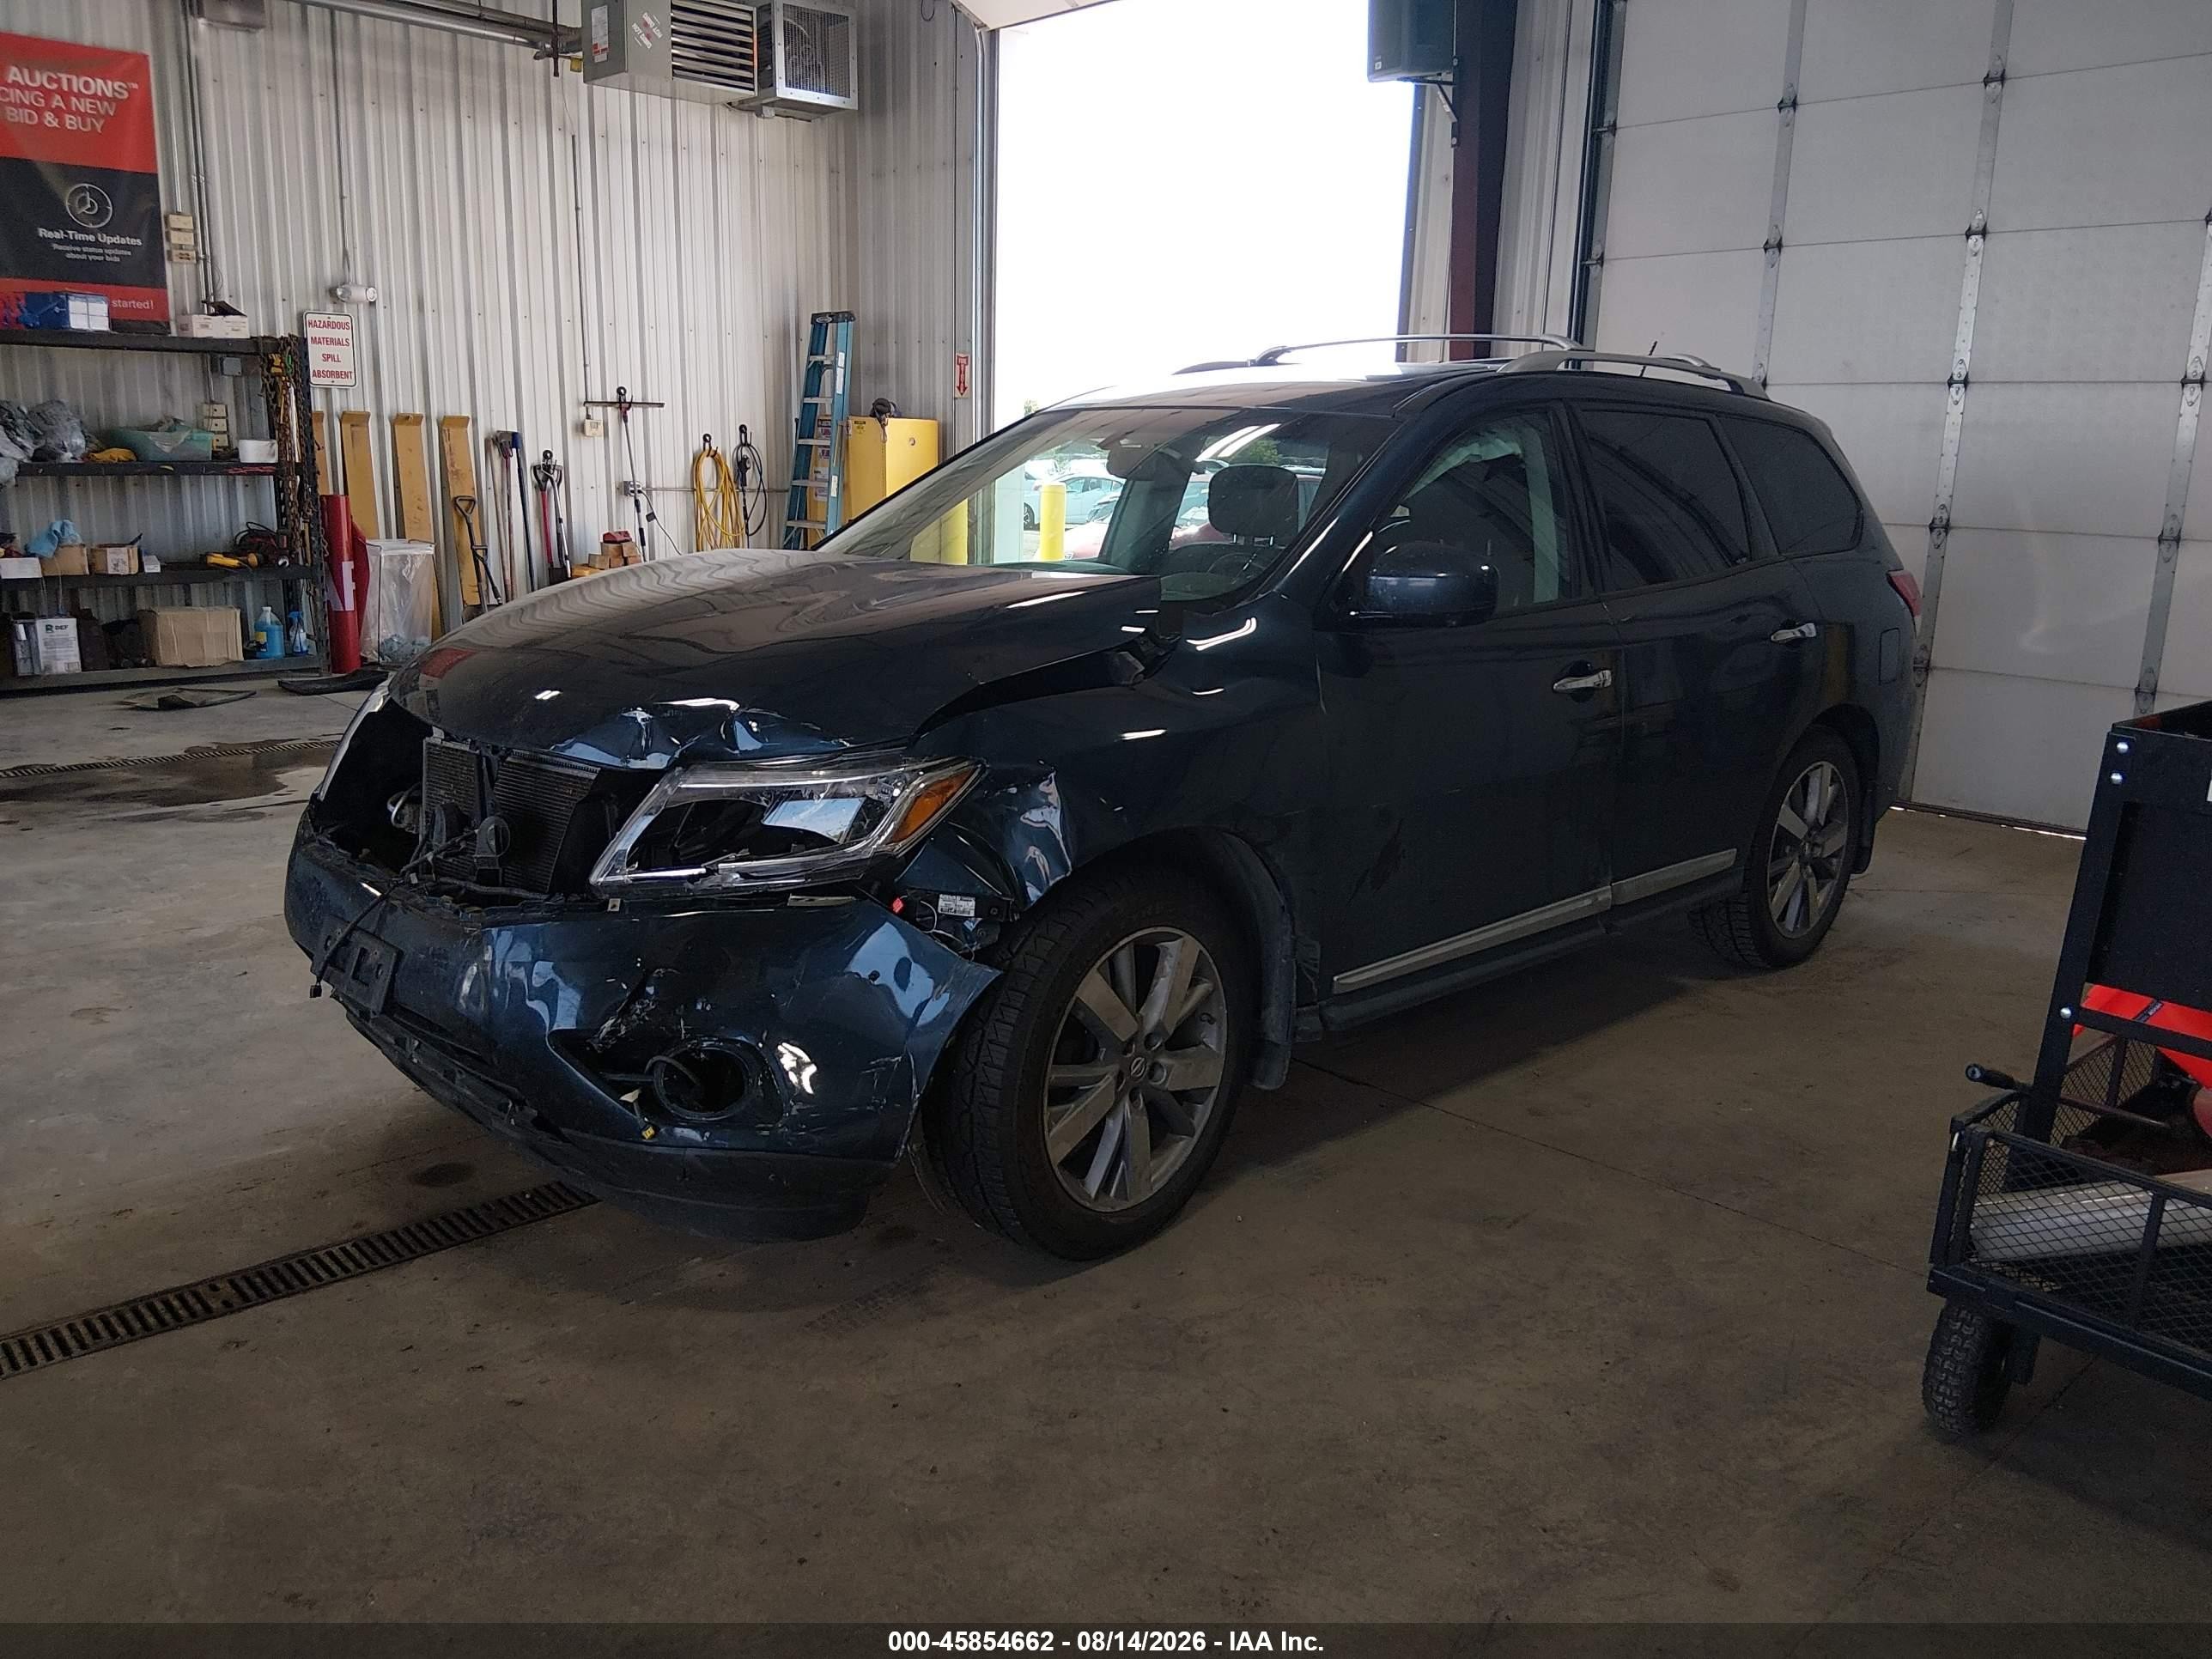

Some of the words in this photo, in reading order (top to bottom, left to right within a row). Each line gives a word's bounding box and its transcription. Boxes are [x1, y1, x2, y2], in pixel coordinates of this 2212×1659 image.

[52, 94, 66, 110] A
[70, 96, 117, 116] NEW
[5, 106, 39, 125] BID
[44, 111, 61, 128] &
[64, 113, 105, 133] BUY
[38, 228, 96, 241] Real-Time
[97, 233, 143, 246] Updates
[112, 298, 154, 310] started!
[307, 319, 350, 330] HAZARDOUS
[310, 337, 349, 346] MATERIALS
[322, 354, 341, 362] SPILL
[312, 369, 353, 380] ABSORBENT
